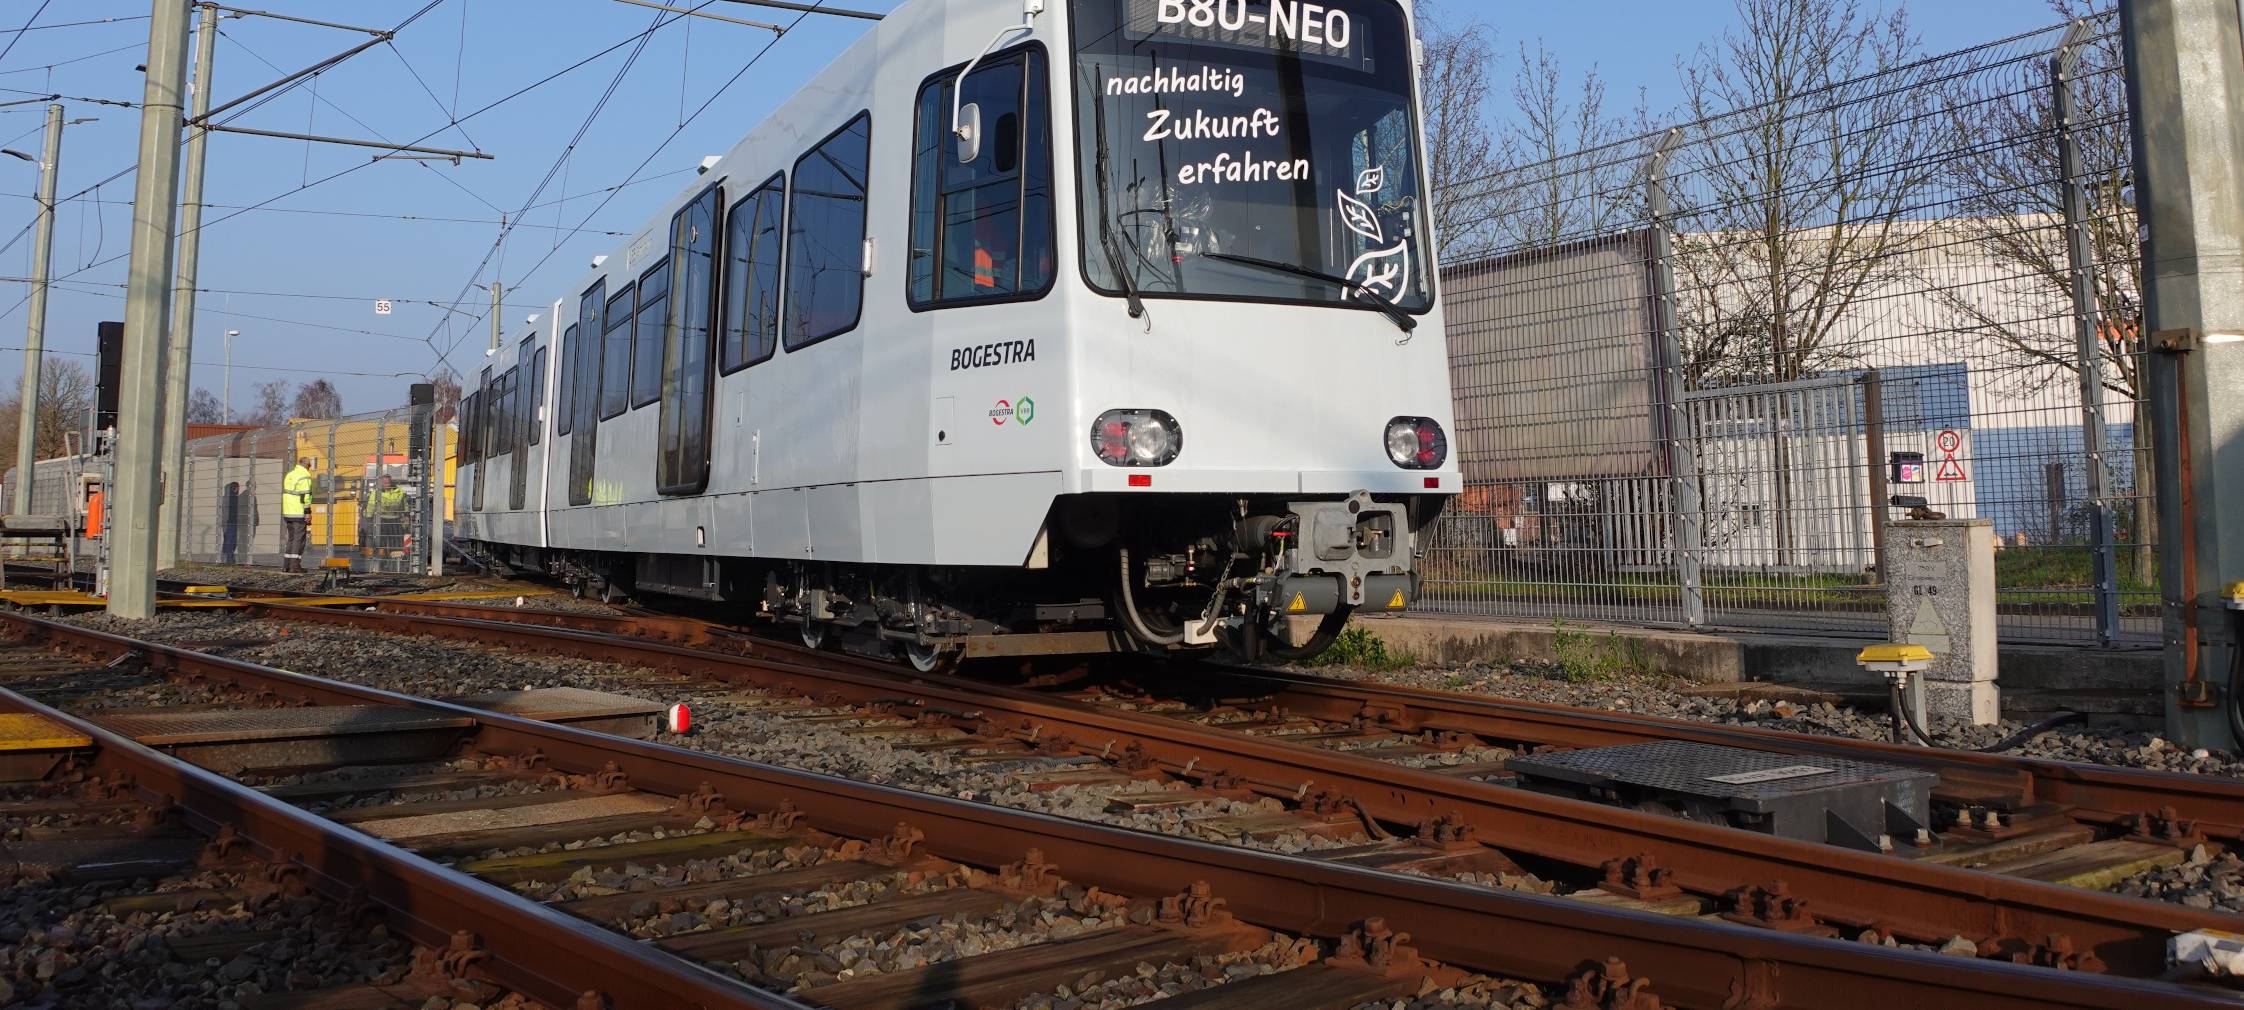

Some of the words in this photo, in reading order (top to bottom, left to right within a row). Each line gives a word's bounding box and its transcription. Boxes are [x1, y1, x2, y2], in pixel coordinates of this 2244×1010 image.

[1157, 0, 1350, 48] B80-NEO
[1107, 66, 1244, 97] nachhaltig
[1143, 108, 1280, 141] Zukunft
[1178, 151, 1309, 185] erfahren
[377, 302, 390, 312] 55
[950, 338, 1035, 371] BOGESTRA
[988, 408, 1014, 417] BOGESTRA
[1943, 436, 1955, 447] 20
